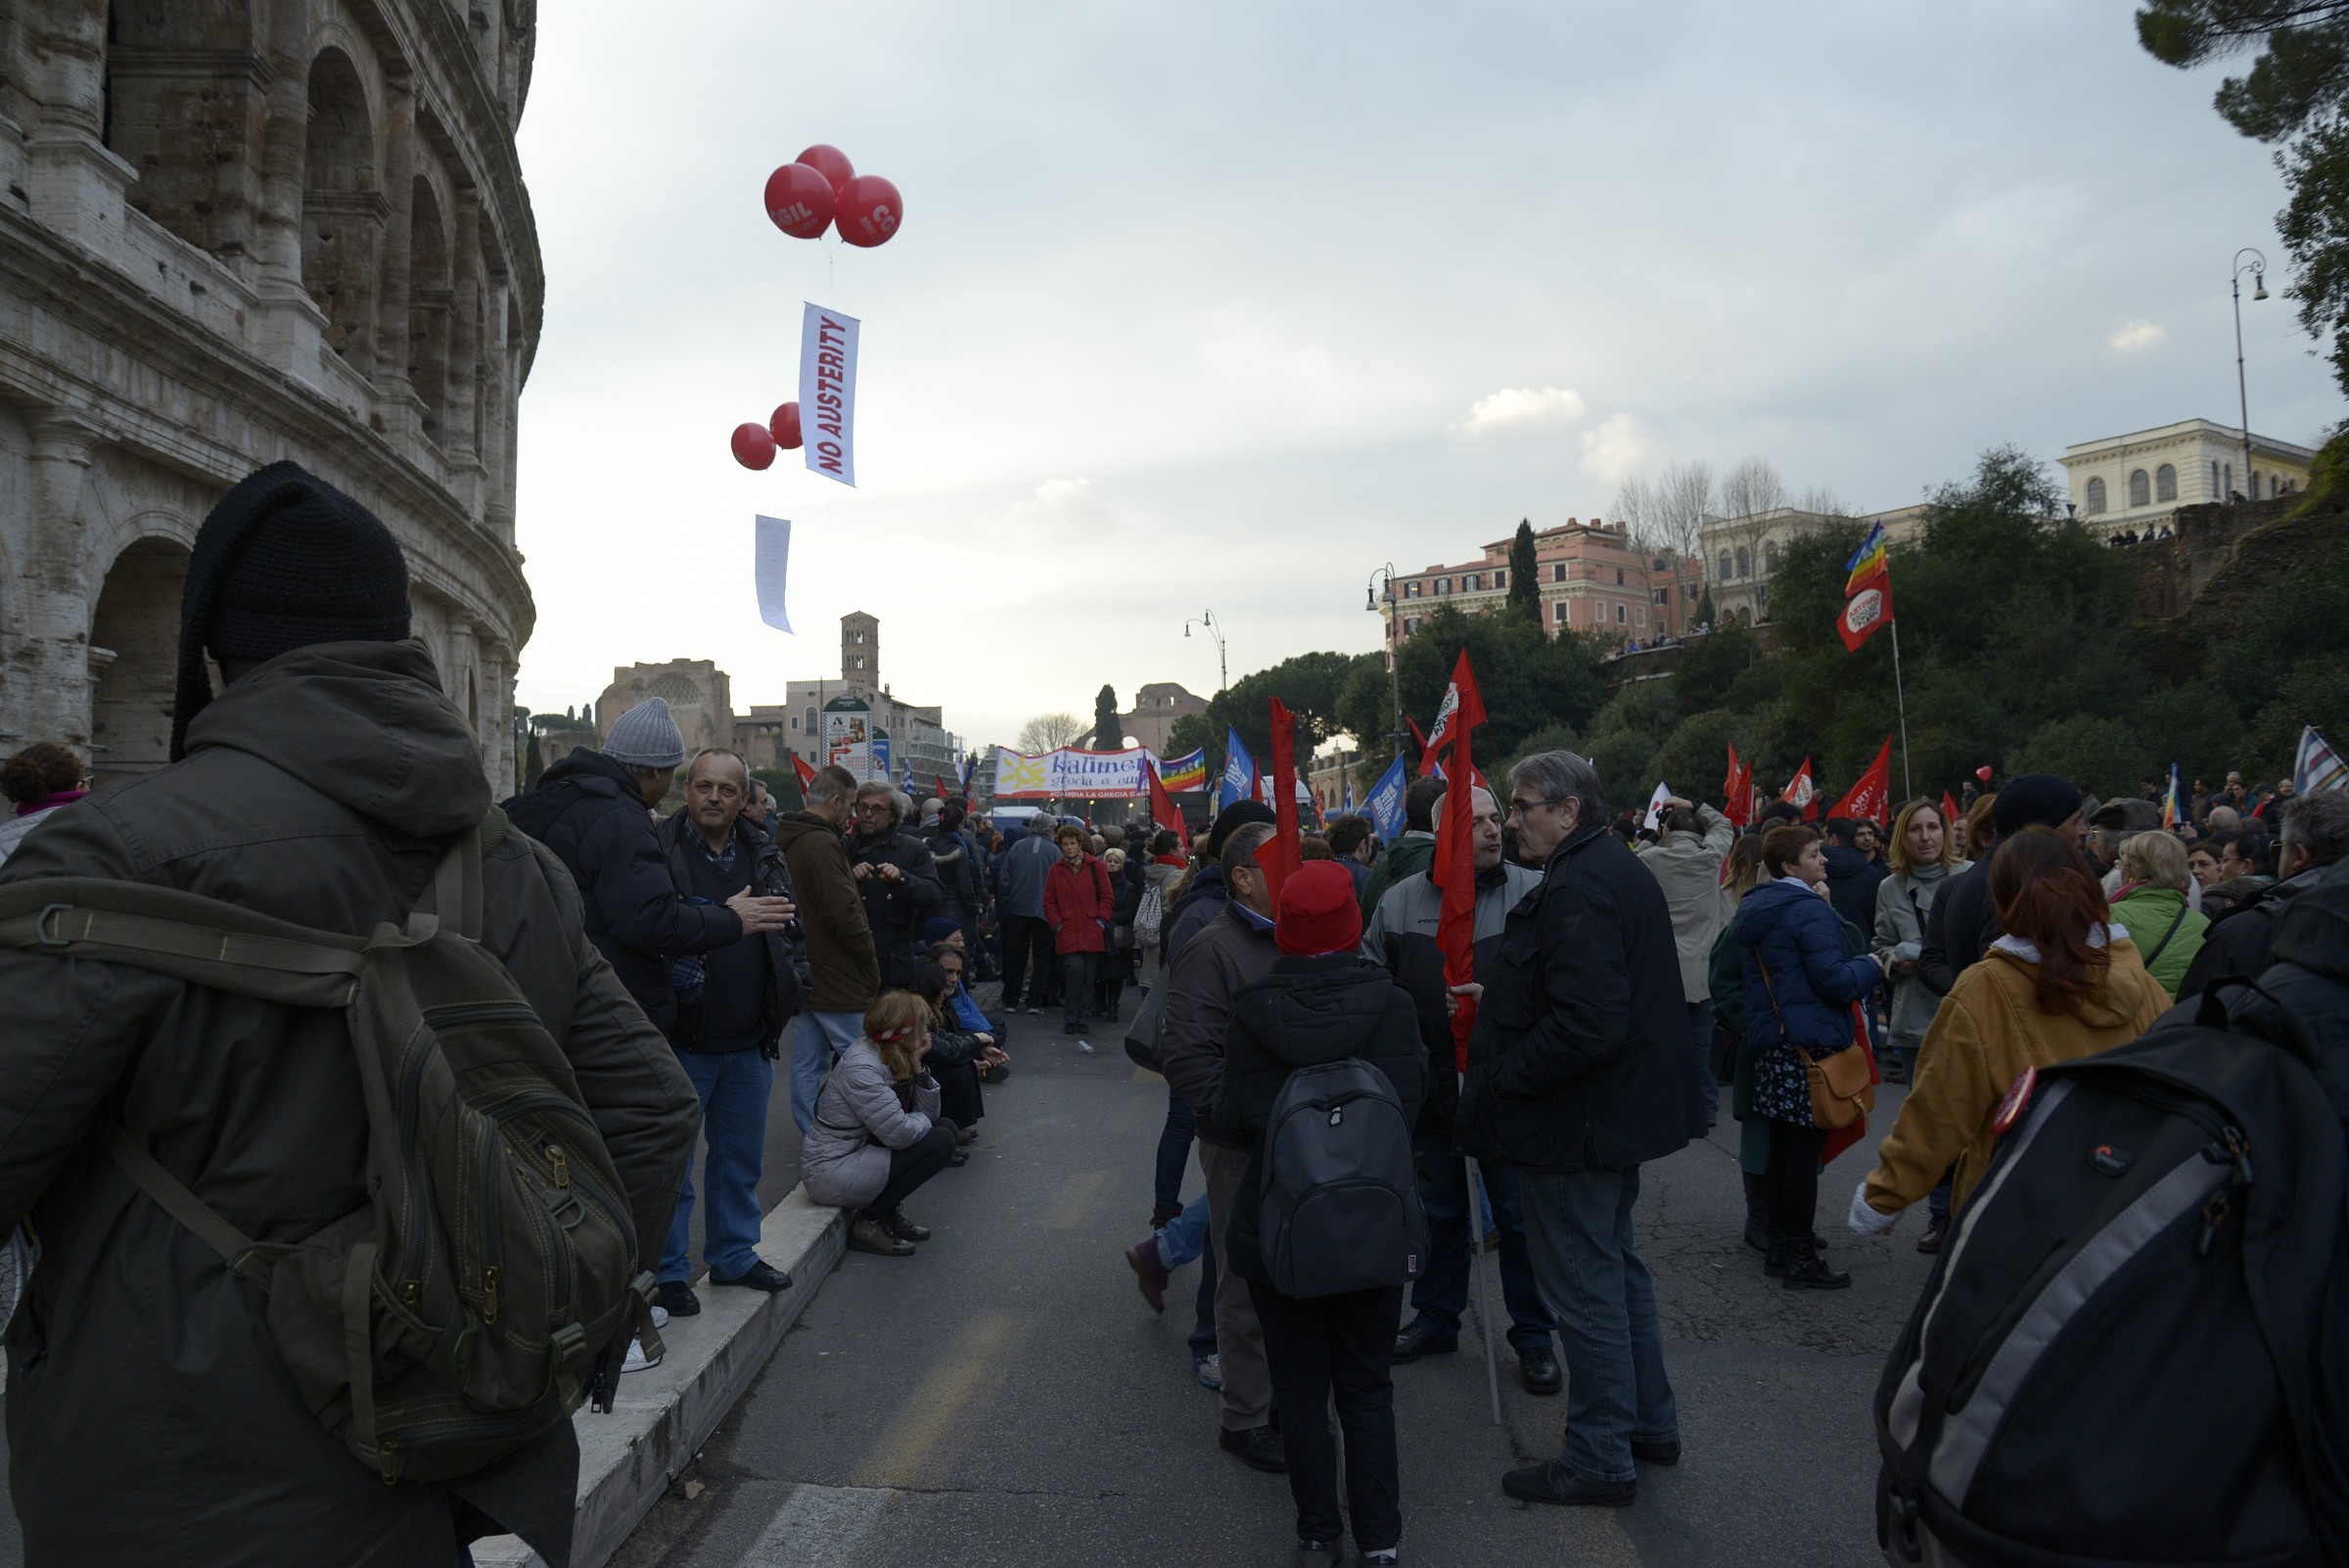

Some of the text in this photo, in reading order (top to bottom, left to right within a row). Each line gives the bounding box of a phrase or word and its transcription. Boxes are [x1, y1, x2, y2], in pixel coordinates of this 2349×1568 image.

[816, 315, 847, 475] NO AUSTERITY
[1171, 760, 1200, 776] PACE
[1051, 776, 1092, 788] grecia
